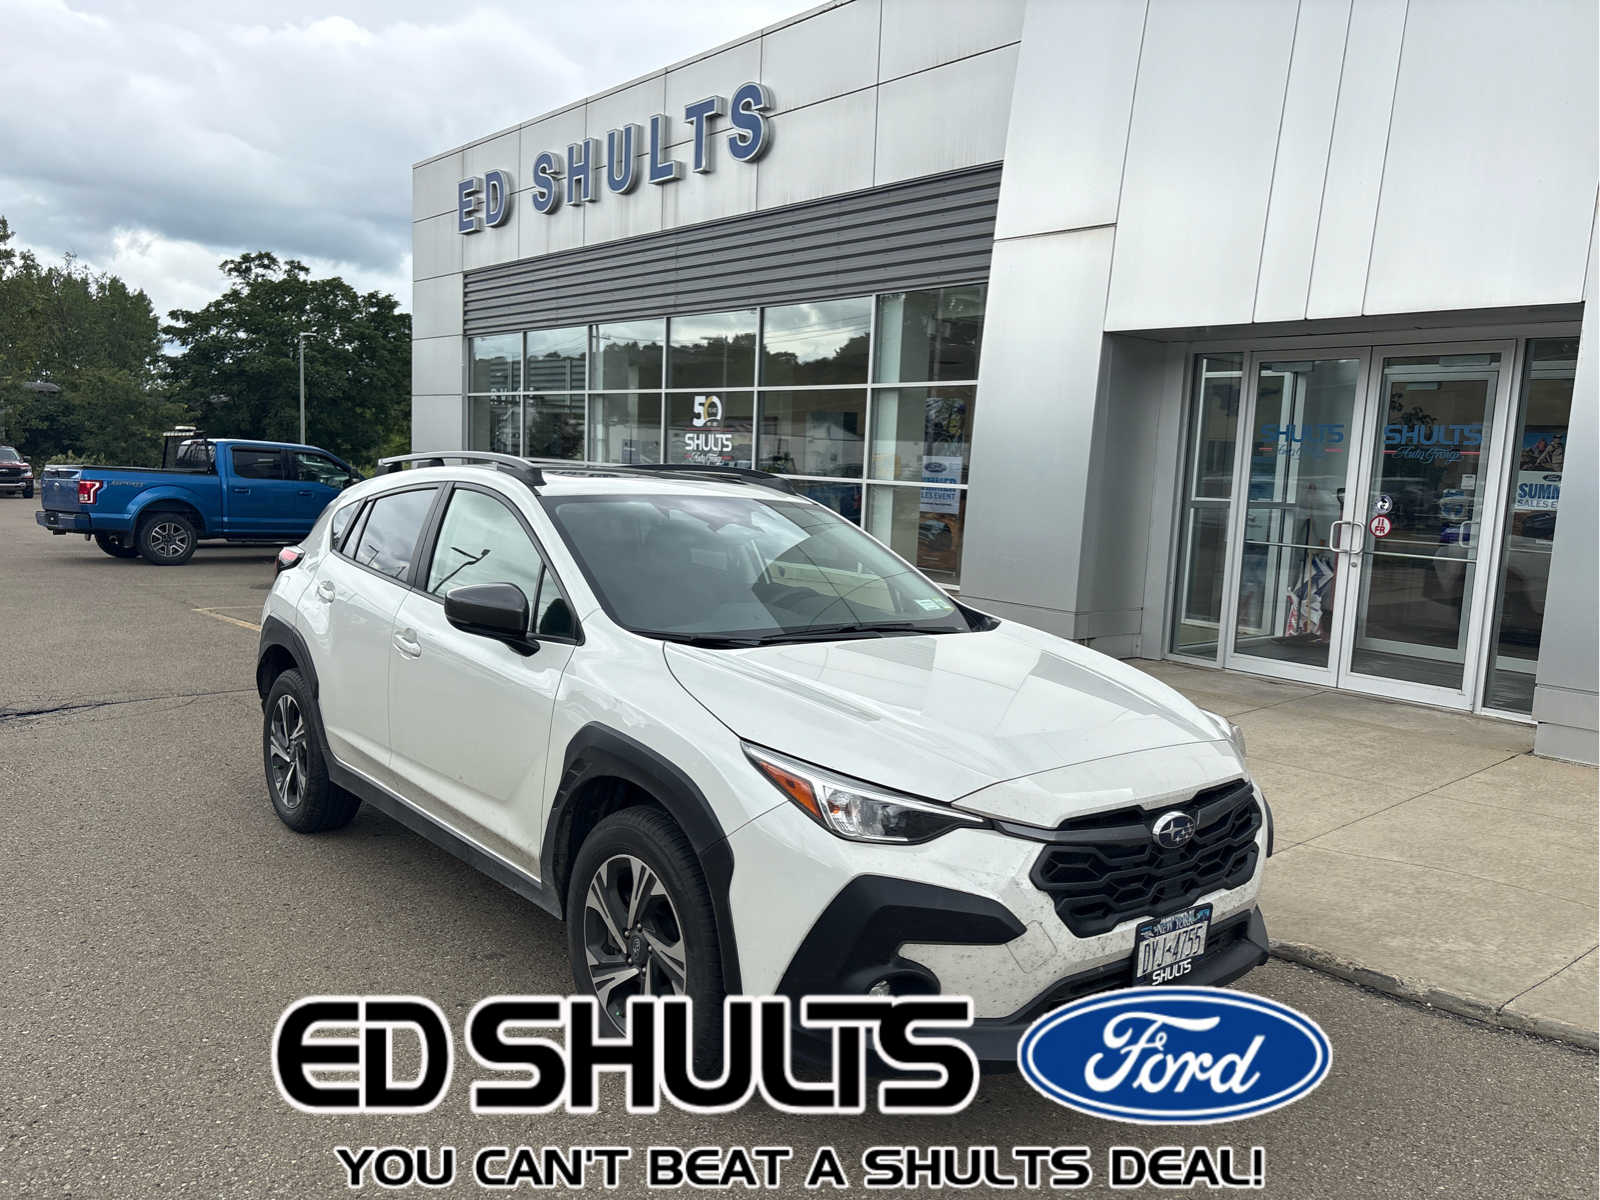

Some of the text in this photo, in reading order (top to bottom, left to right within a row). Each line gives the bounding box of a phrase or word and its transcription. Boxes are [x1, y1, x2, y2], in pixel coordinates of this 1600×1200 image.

[458, 80, 774, 235] ED SHULTS
[692, 395, 722, 427] 50
[684, 433, 732, 452] SHULTS
[1261, 424, 1345, 443] SHULTS
[1383, 424, 1483, 446] SHULTS
[1517, 499, 1549, 509] SALES
[1151, 959, 1192, 986] SHULTS
